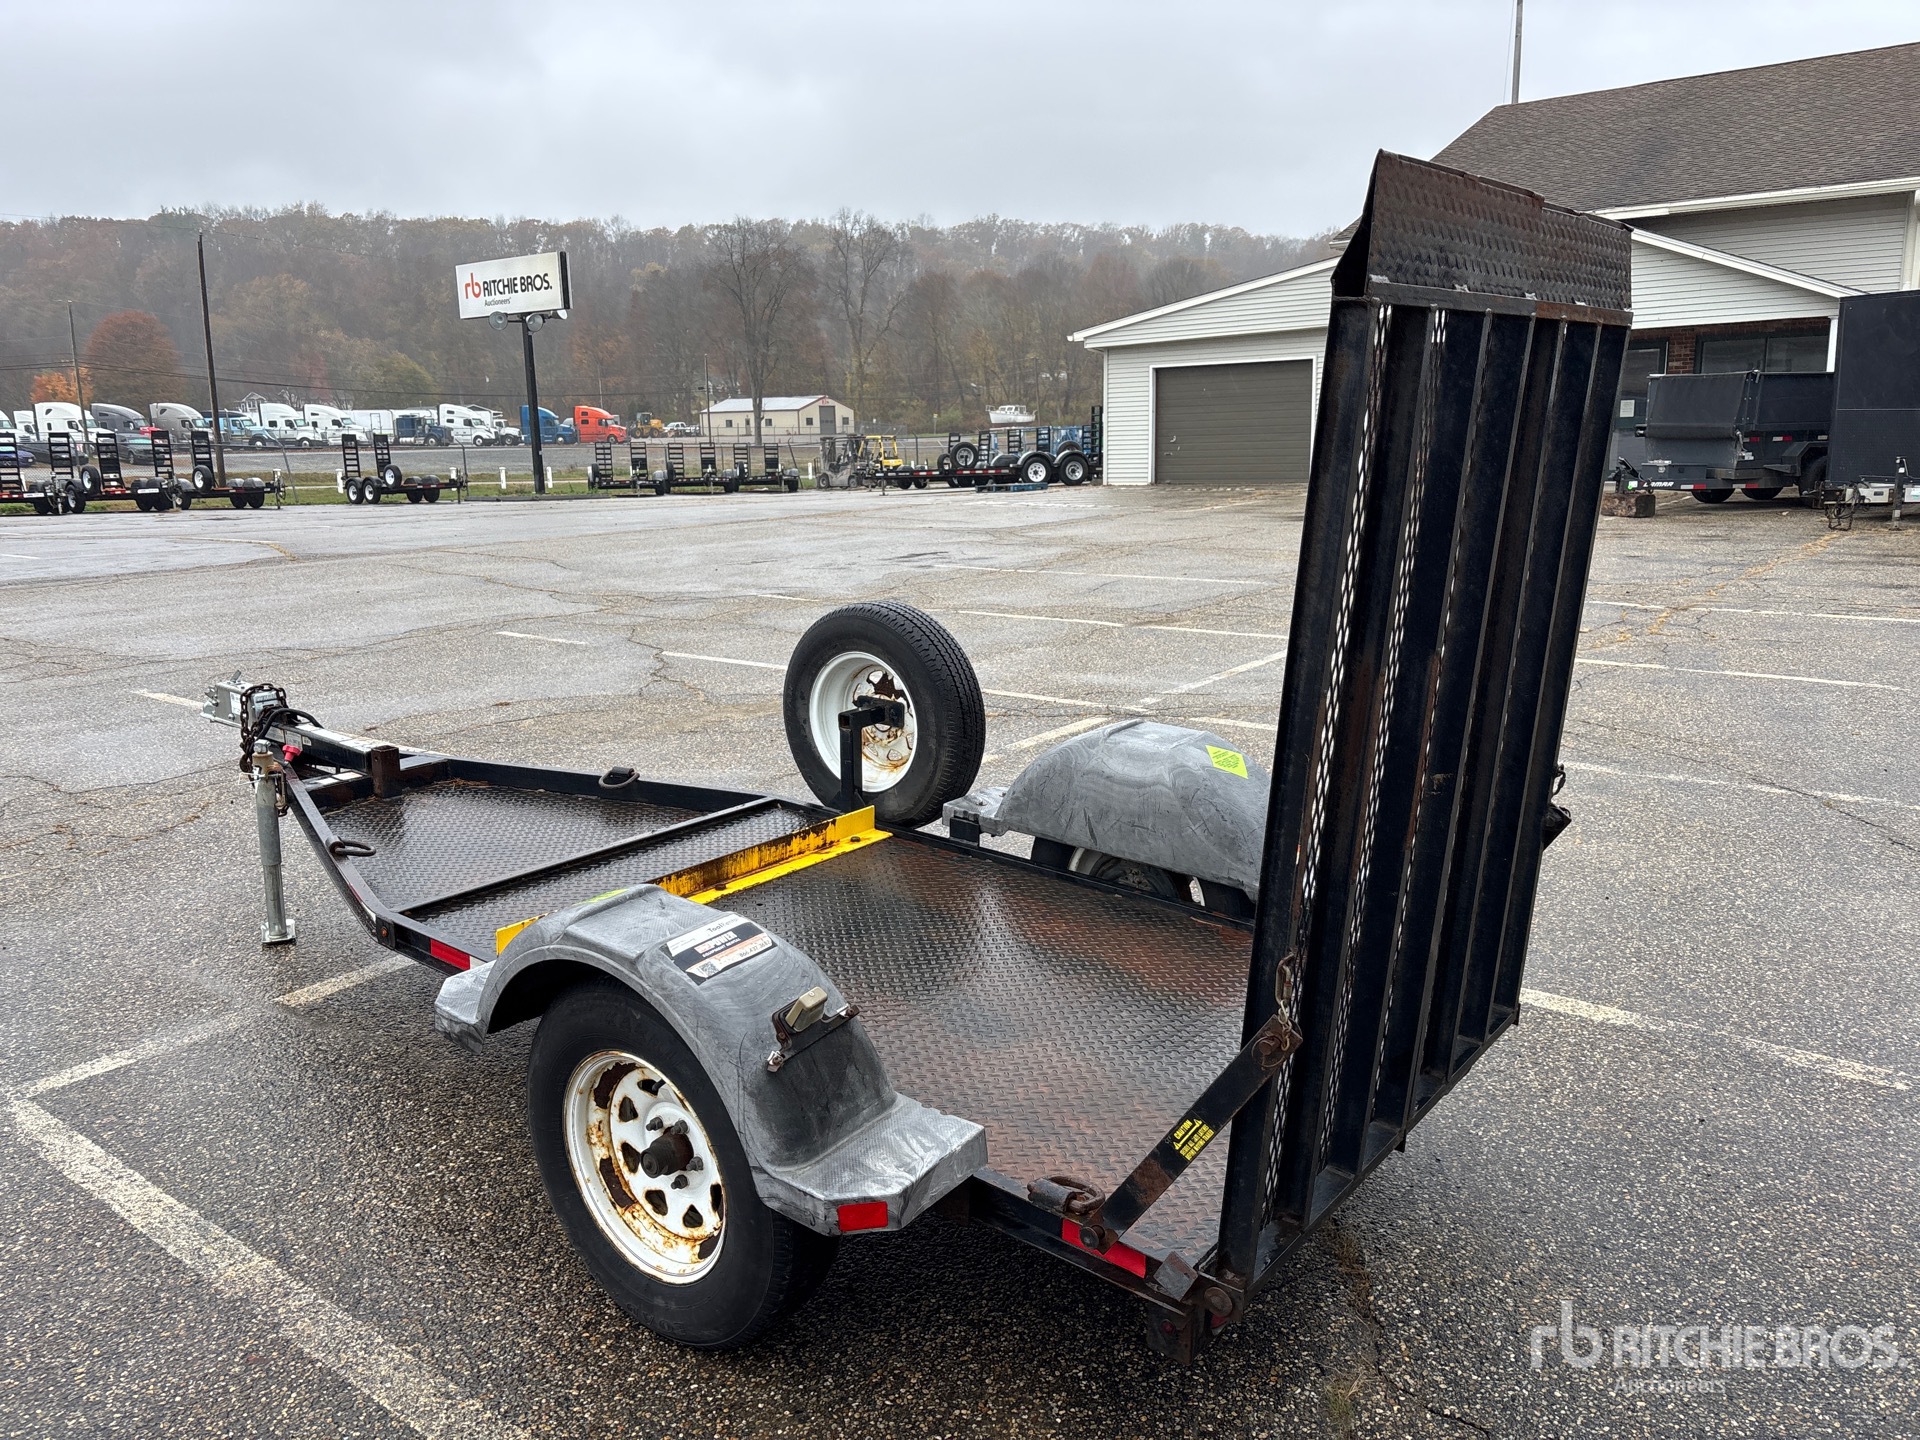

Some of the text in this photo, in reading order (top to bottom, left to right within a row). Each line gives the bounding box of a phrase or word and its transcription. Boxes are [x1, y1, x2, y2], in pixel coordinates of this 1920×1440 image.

[464, 272, 553, 299] rb RITCHIE BROS.
[1173, 1119, 1193, 1140] CAUTION
